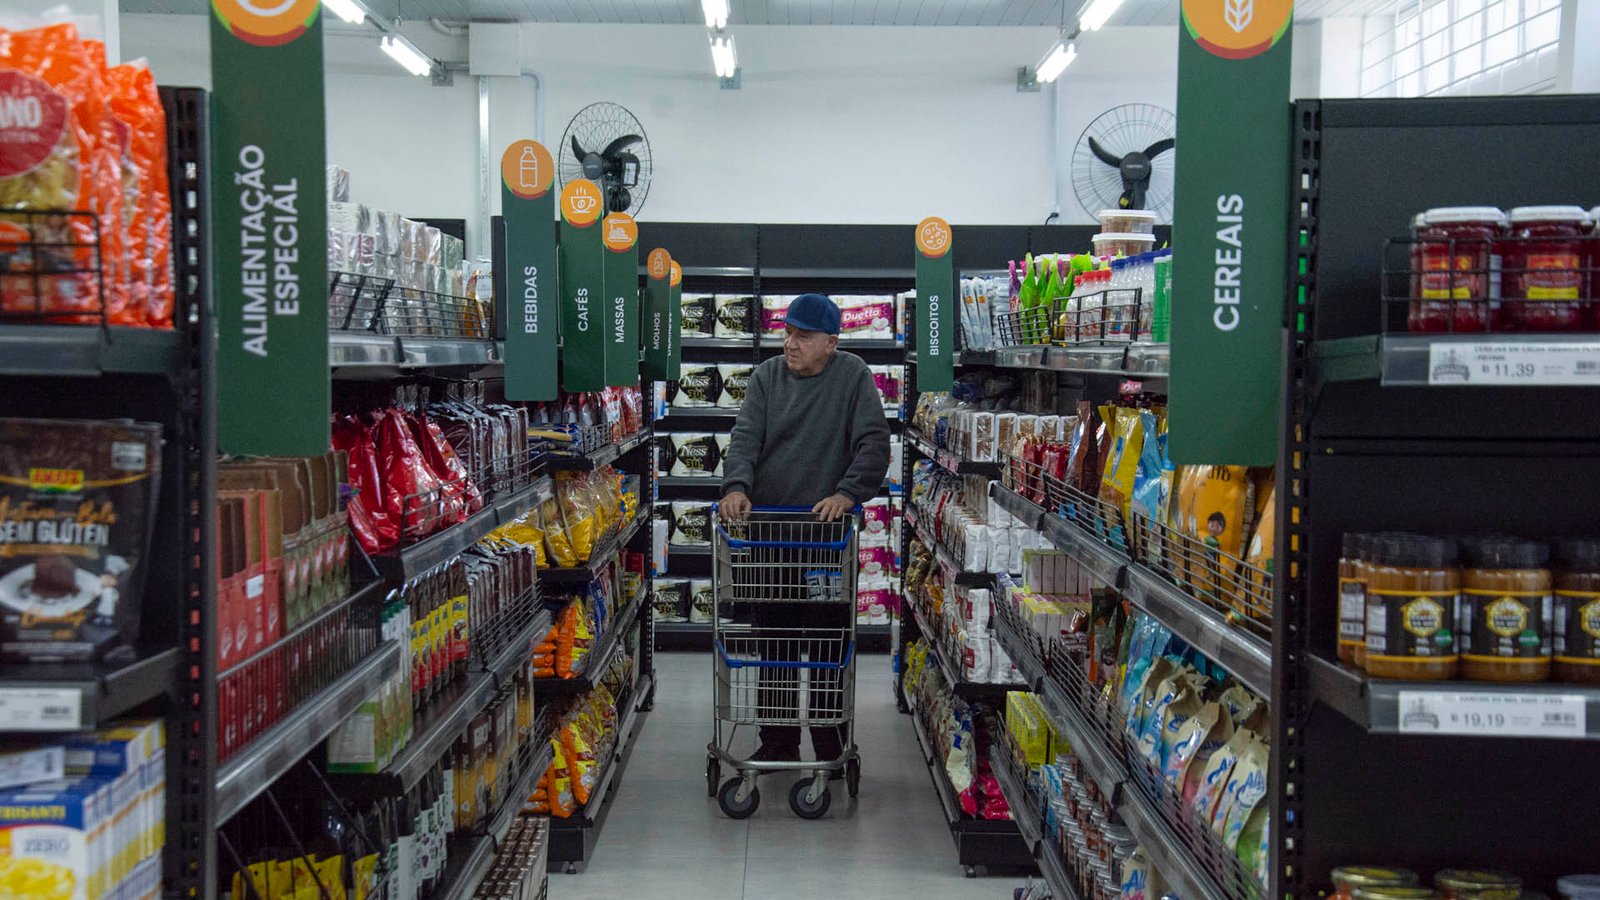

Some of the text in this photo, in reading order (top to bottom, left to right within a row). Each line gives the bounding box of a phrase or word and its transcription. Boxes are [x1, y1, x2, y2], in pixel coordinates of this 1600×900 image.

[234, 145, 273, 357] ALIMENTAÇÃO
[272, 178, 299, 315] ESPECIAL
[1213, 194, 1244, 331] CEREAIS
[524, 266, 538, 334] BEBIDAS
[575, 288, 588, 332] CAFÉS
[720, 306, 746, 318] Ness
[615, 297, 625, 343] MASSAS
[843, 308, 880, 322] Duetto
[929, 295, 939, 356] BISCOITOS
[653, 312, 661, 350] MOLHOS
[681, 376, 709, 387] Ness
[728, 376, 748, 387] Nes
[680, 445, 707, 457] Ness
[680, 515, 706, 527] Ness
[654, 591, 681, 602] Ness
[23, 838, 72, 854] ZERO
